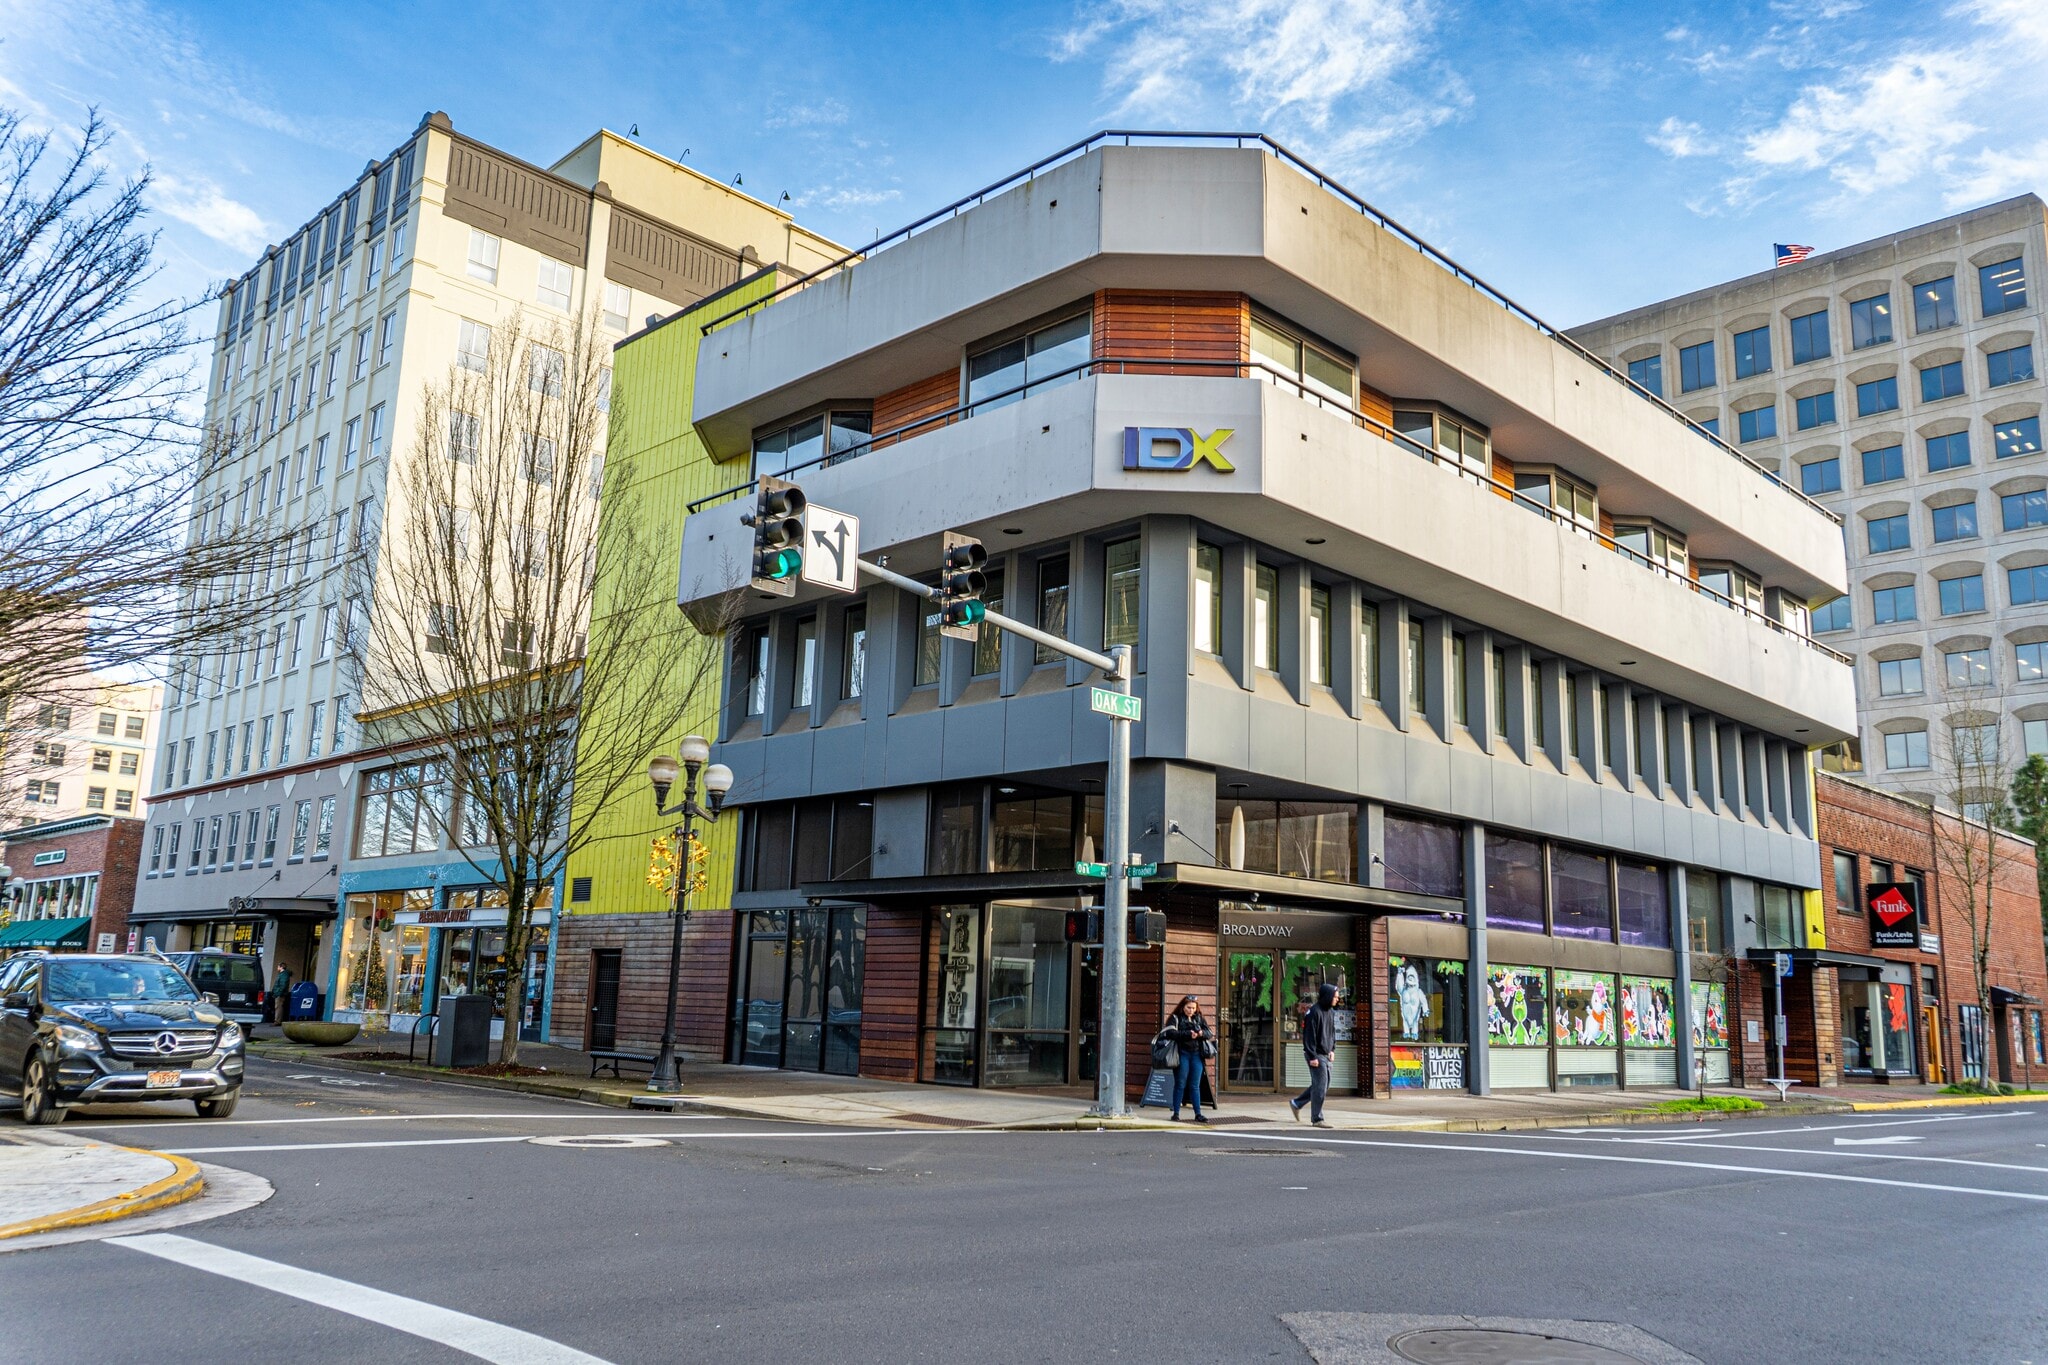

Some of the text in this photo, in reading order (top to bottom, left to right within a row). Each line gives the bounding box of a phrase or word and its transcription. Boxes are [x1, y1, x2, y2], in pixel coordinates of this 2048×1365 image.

[1123, 426, 1236, 473] IDX
[1095, 692, 1138, 717] OAK ST
[1876, 900, 1908, 913] Funk
[1223, 923, 1294, 938] BROADWAY
[1429, 1046, 1461, 1059] BLACK
[1430, 1060, 1461, 1077] LIVES
[1428, 1078, 1462, 1089] MATTER
